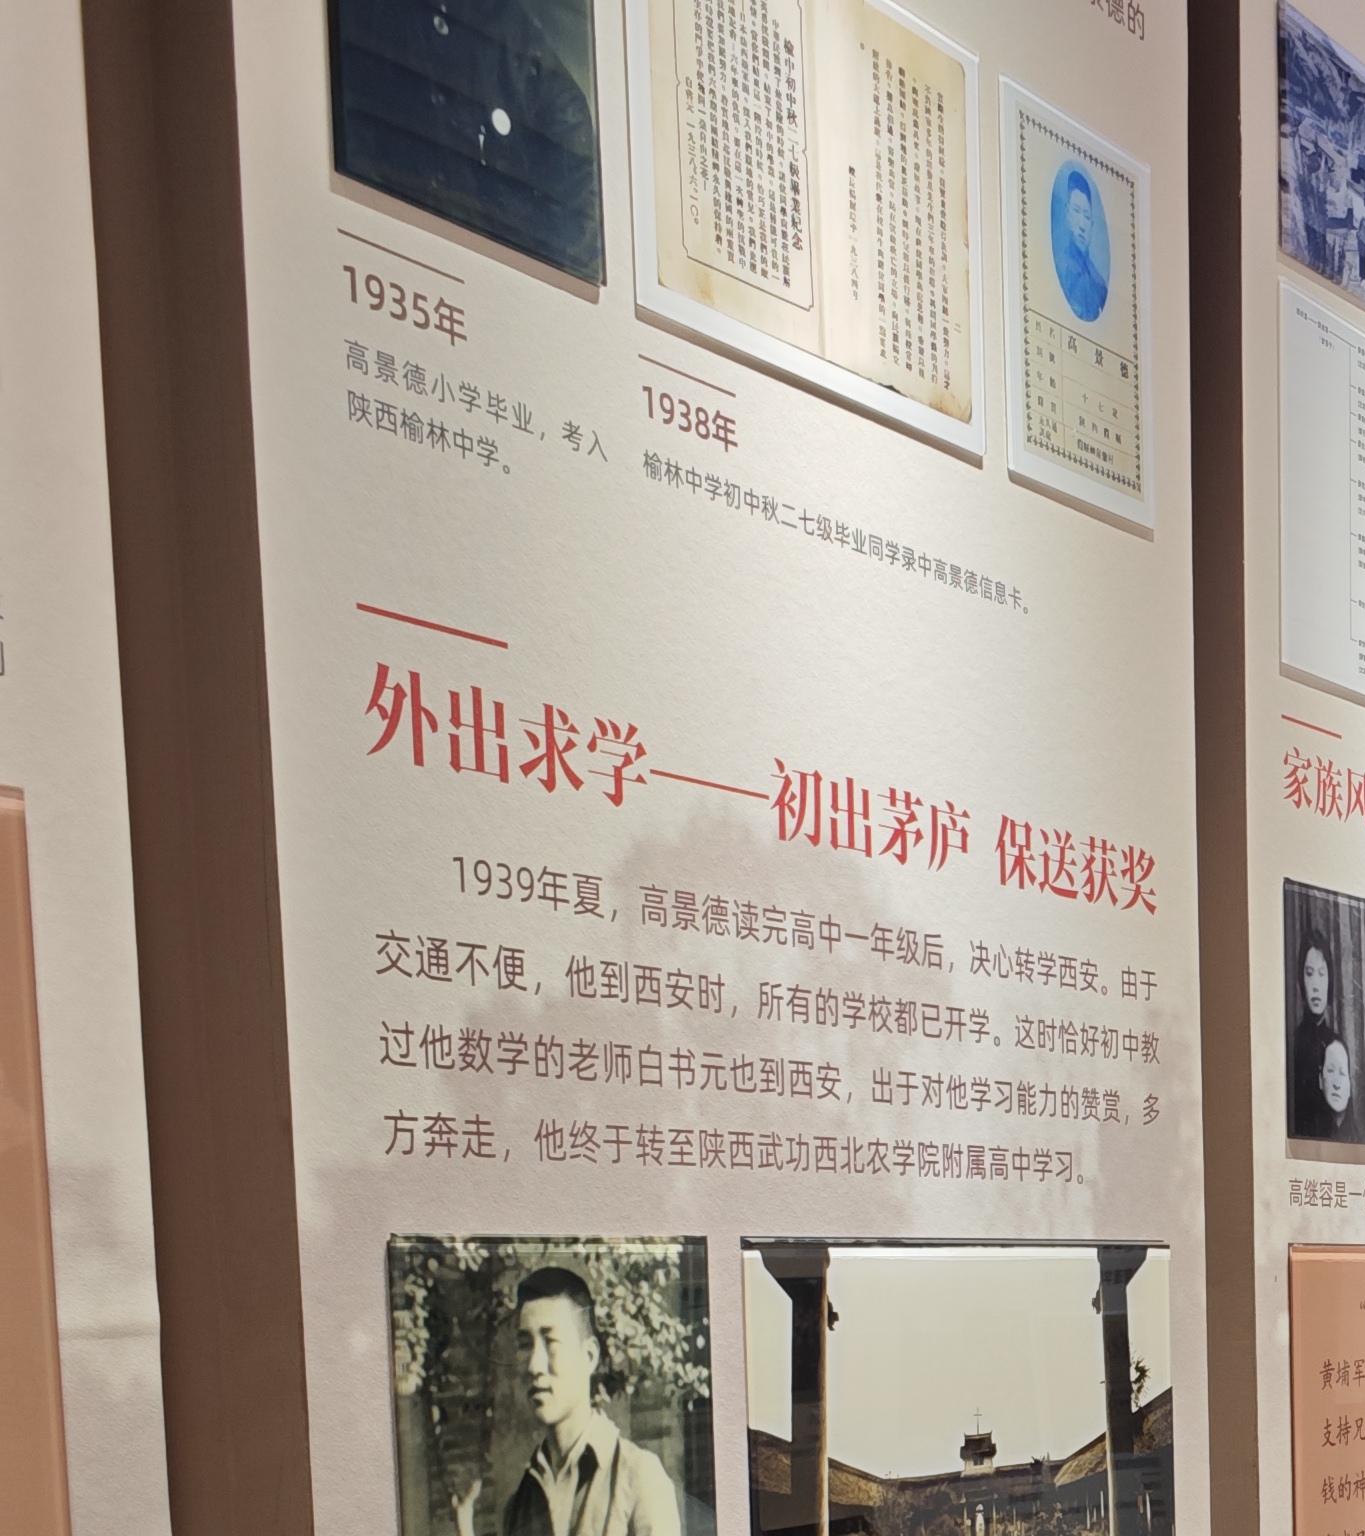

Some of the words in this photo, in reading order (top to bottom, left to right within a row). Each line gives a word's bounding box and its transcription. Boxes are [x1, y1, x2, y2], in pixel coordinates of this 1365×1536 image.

[342, 264, 469, 348] 1935年
[343, 339, 609, 464] 高景德小学毕业，考入
[345, 390, 512, 477] 陕西榆林中学。
[642, 383, 739, 454] 1938年
[641, 449, 1030, 617] 榆林中学初中秋二七级毕业同学录中高景德信息卡。
[364, 660, 973, 872] 外出求学——初出茅庐
[993, 812, 1161, 917] 保送获奖
[451, 854, 1160, 1005] 1939年夏，高景德读完高中一年级后，决心转学西安。由于
[374, 928, 1162, 1067] 交通不便，他到西安时，所有的学校都已开学。这时恰好初中教
[378, 1018, 1162, 1128] 过他数学的老师白书元也到西安，出于对他学习能力的赞赏，多
[382, 1108, 1087, 1187] 方奔走，他终于转至陕西武功西北农学院附属高中学习。
